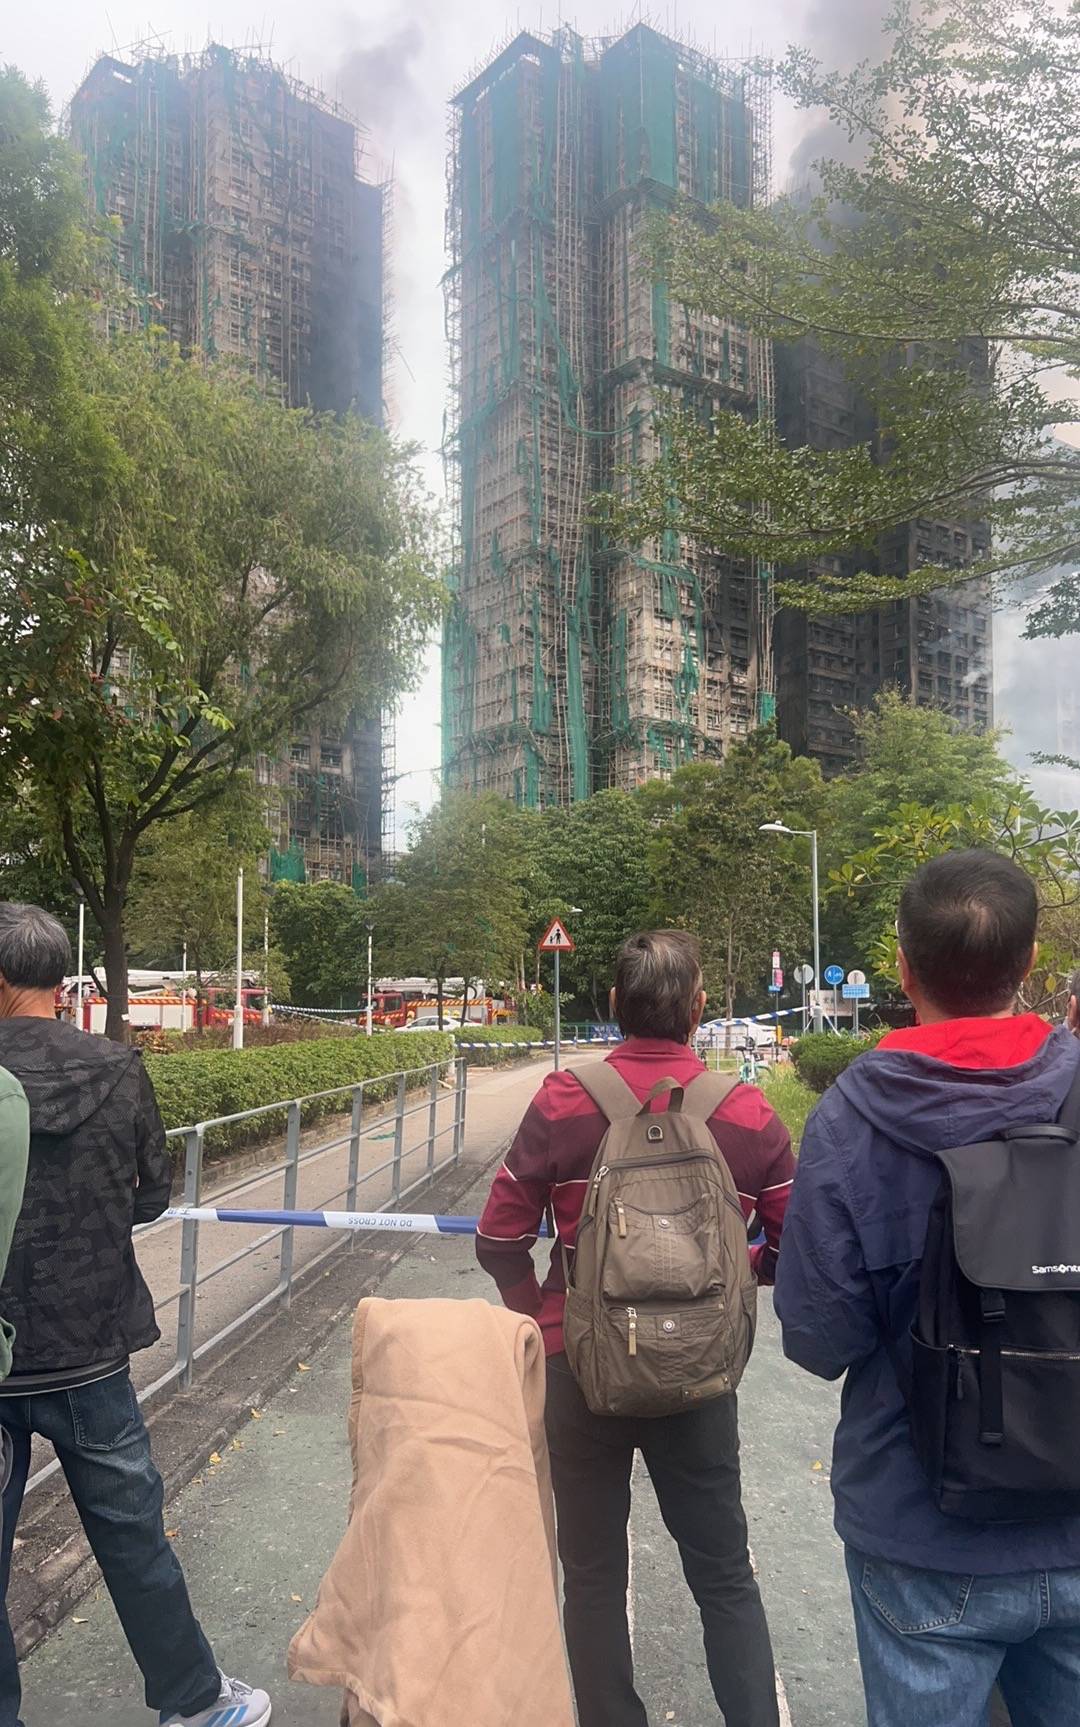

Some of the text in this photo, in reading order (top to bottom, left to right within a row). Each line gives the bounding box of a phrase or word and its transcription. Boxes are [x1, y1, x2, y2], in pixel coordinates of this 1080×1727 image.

[348, 1217, 413, 1228] DO NOT CROSS
